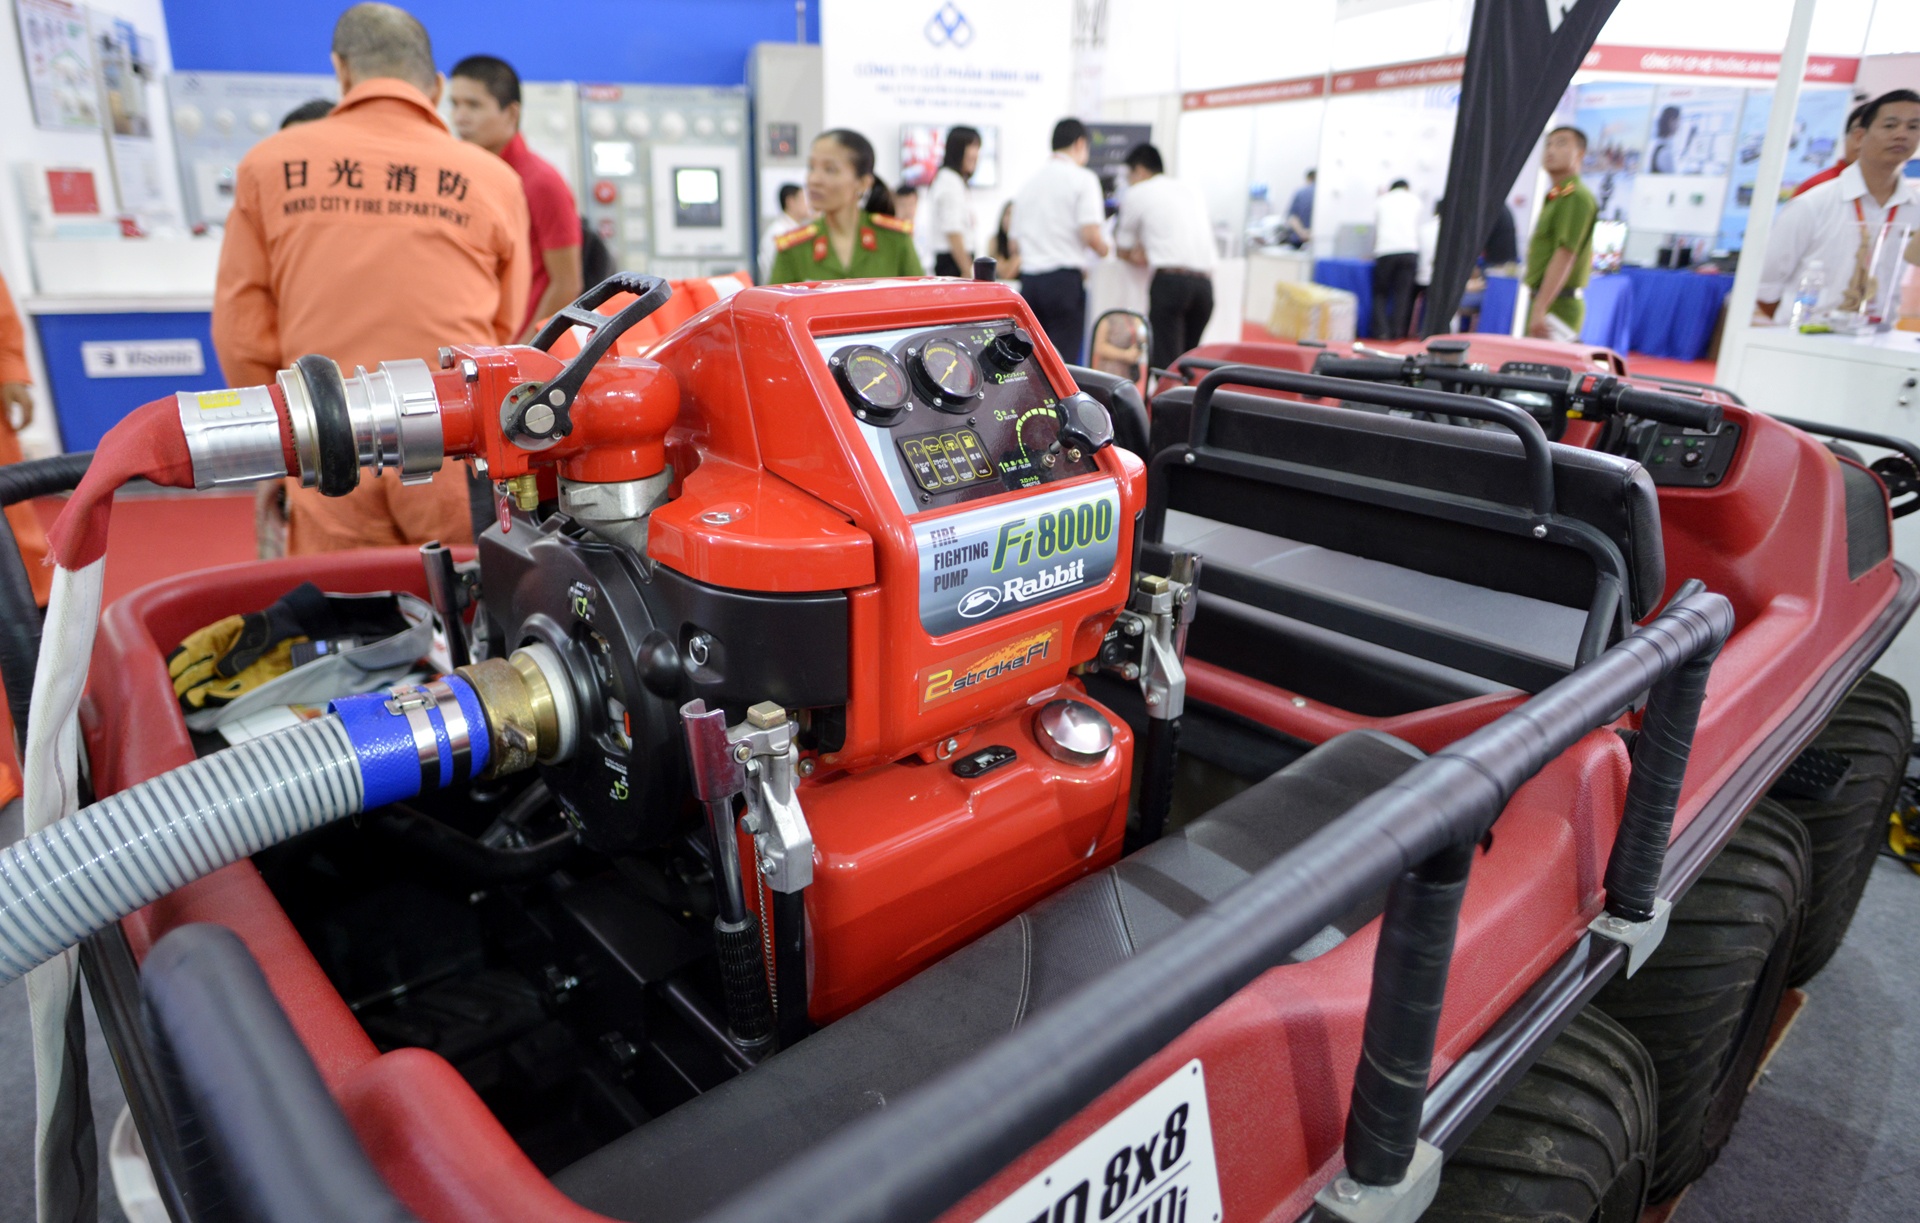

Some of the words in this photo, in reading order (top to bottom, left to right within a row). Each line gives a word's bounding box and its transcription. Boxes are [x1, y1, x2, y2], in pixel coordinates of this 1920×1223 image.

[284, 159, 469, 201] 日光消防
[284, 196, 317, 216] NIKKO
[320, 196, 350, 213] CITY
[355, 198, 383, 215] FIRE
[388, 201, 471, 228] DEPARTMENT
[995, 373, 1005, 384] 2
[993, 409, 1004, 421] 3
[930, 526, 958, 548] FIRE
[934, 541, 989, 570] FIGHTING
[933, 569, 968, 592] PUMP
[1003, 558, 1084, 602] Rabbit
[1099, 1102, 1189, 1221] 8x8
